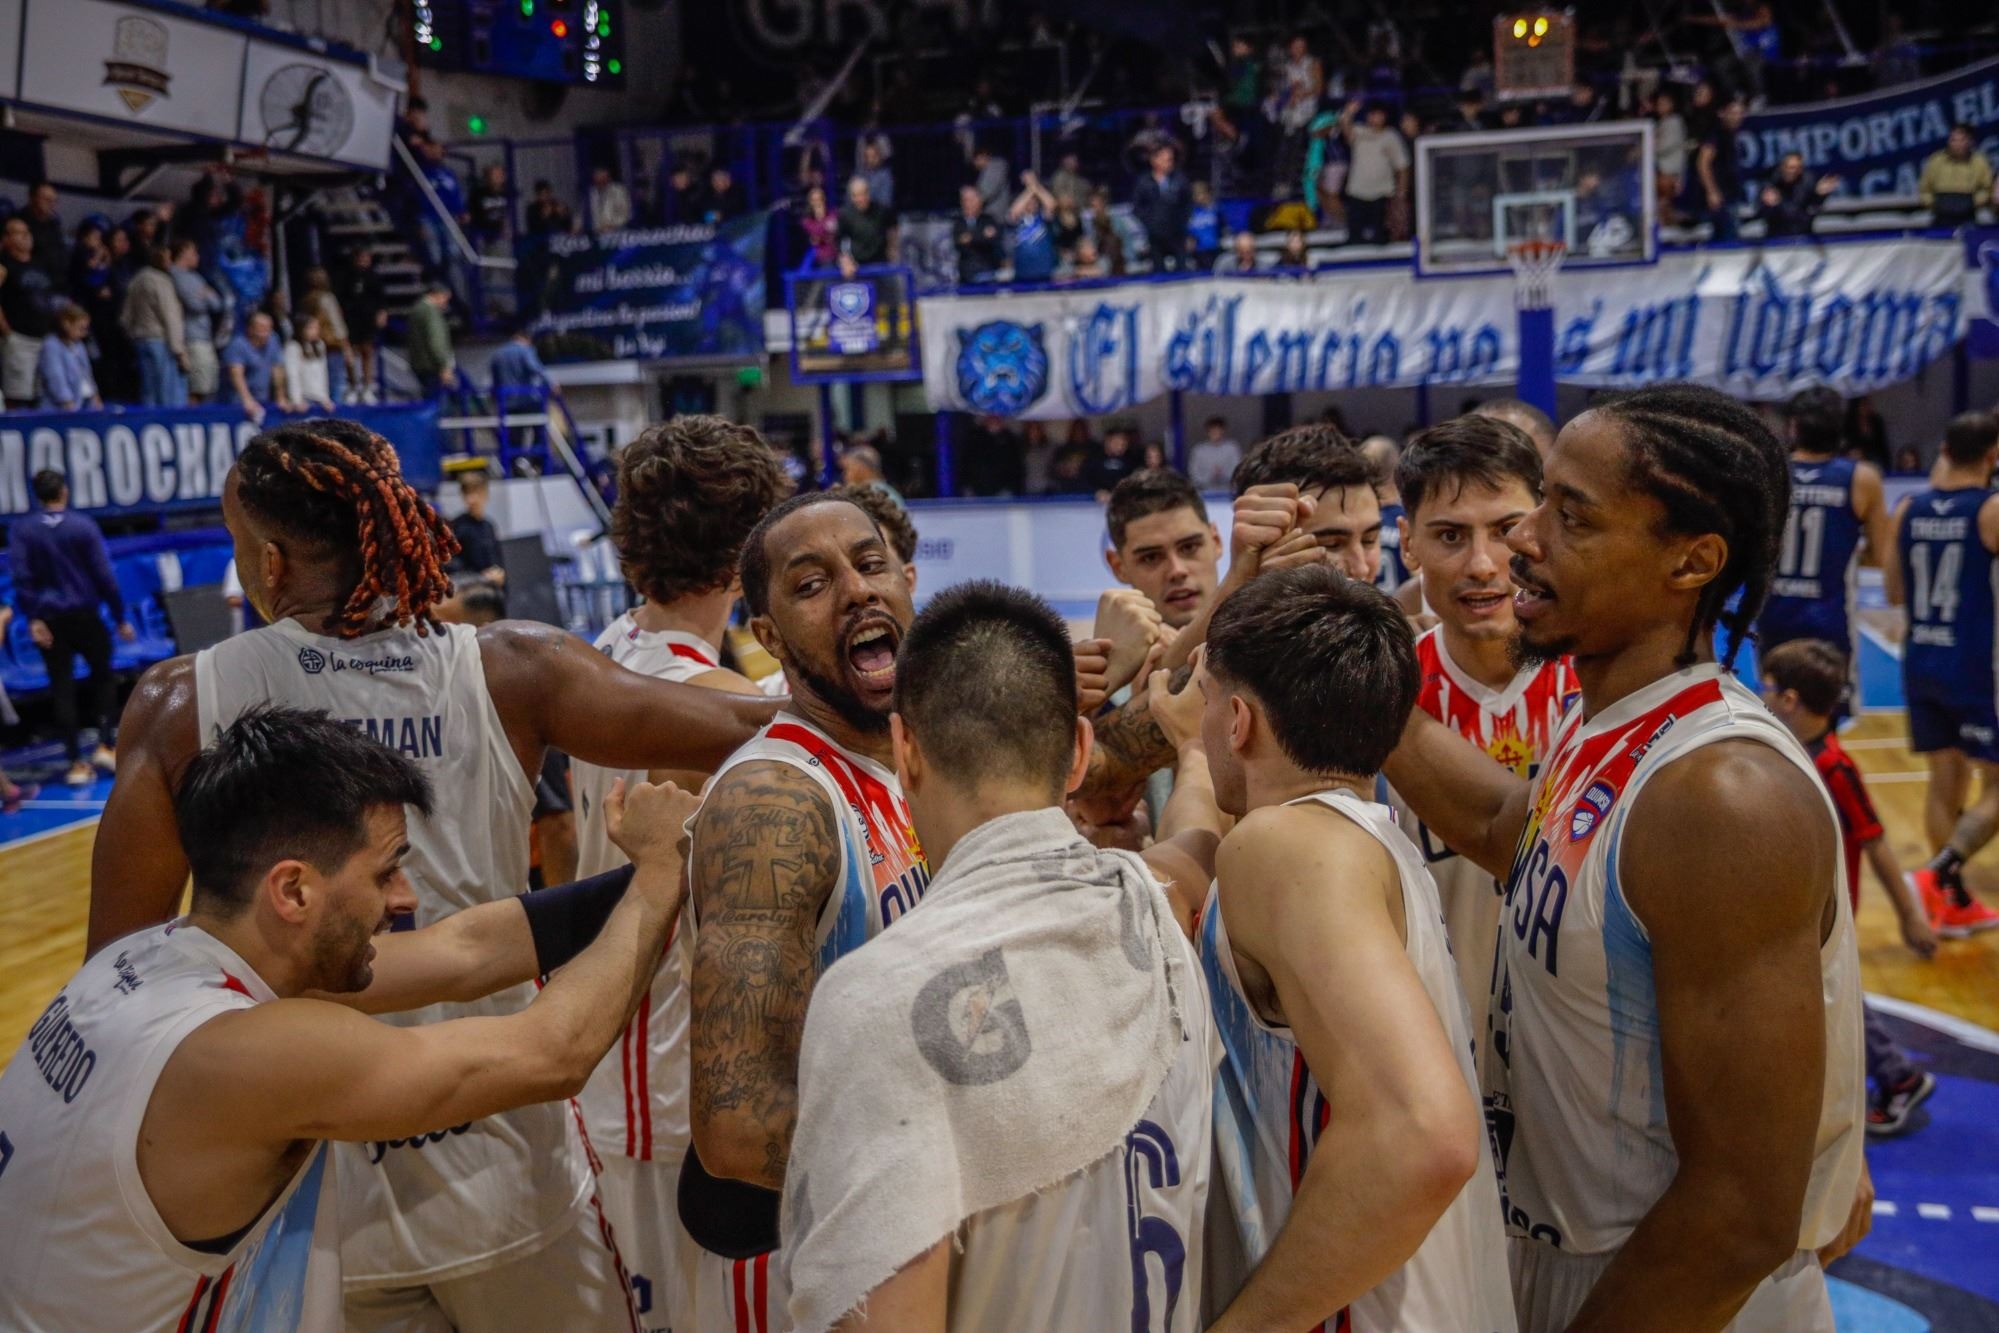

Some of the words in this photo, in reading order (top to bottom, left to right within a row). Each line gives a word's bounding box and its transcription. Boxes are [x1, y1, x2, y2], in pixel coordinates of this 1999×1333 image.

[1762, 101, 1949, 166] IMPORTA
[1424, 323, 1504, 385] no
[1910, 542, 1964, 622] 14
[350, 656, 414, 675] esquina
[28, 985, 96, 1104] GUEREDO
